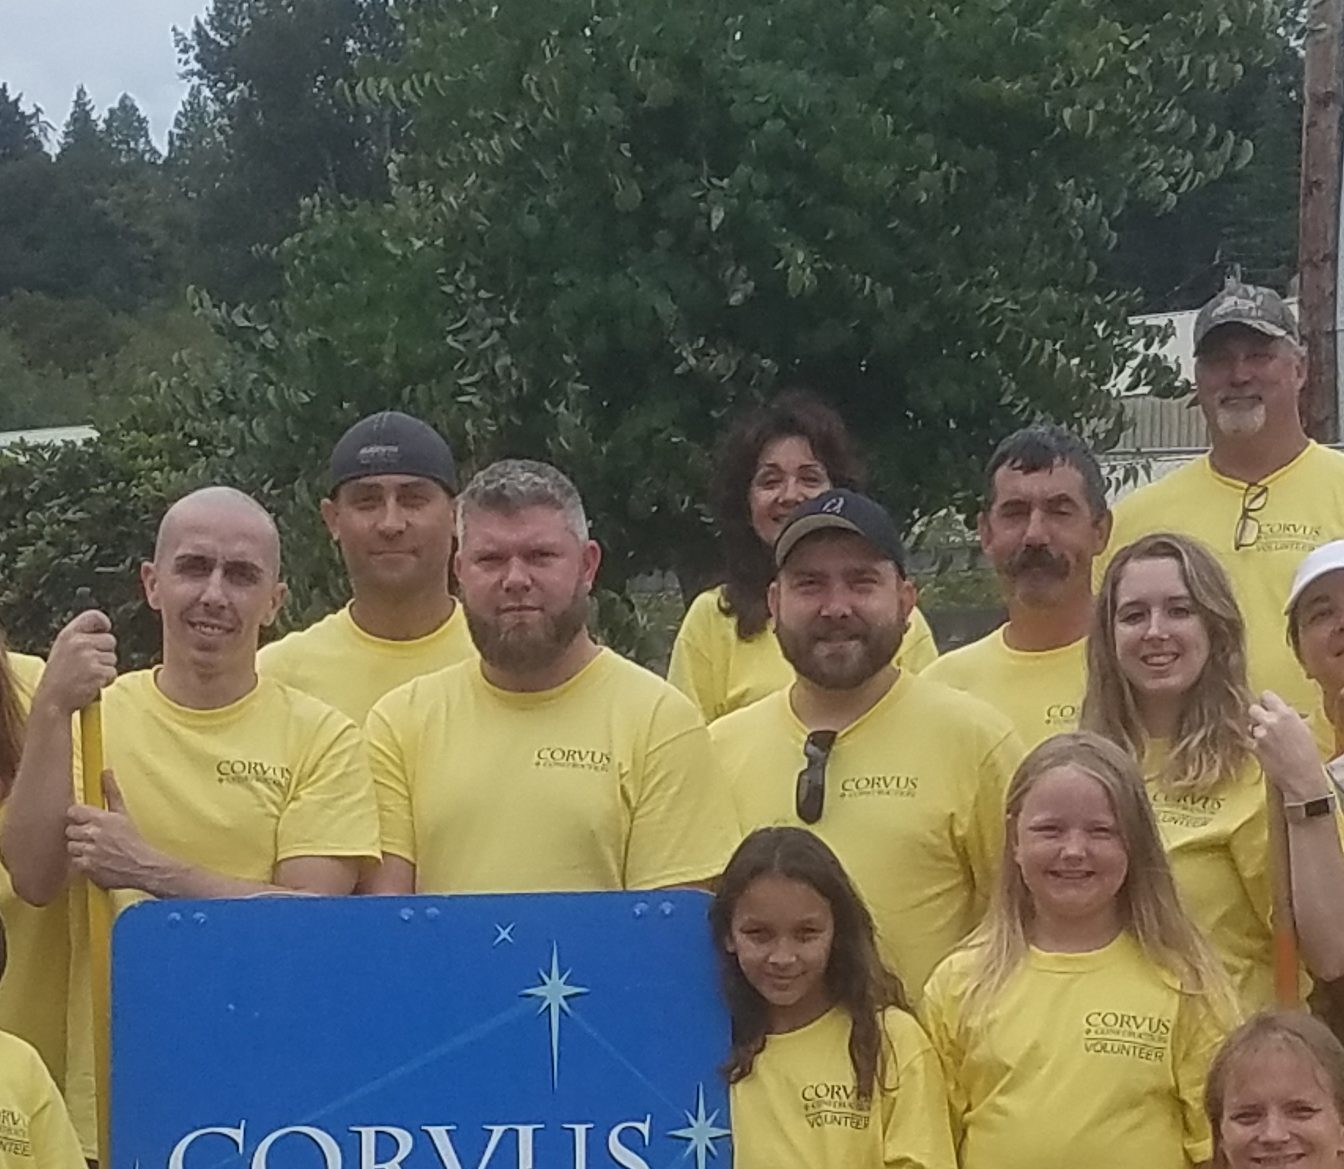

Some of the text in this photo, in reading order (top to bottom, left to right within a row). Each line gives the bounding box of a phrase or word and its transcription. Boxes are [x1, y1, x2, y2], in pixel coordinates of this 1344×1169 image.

[537, 747, 611, 764] CORVUS
[841, 775, 919, 792] CORVUS
[1085, 1011, 1172, 1036] CORVUS
[1084, 1042, 1165, 1062] VOLUNTEER
